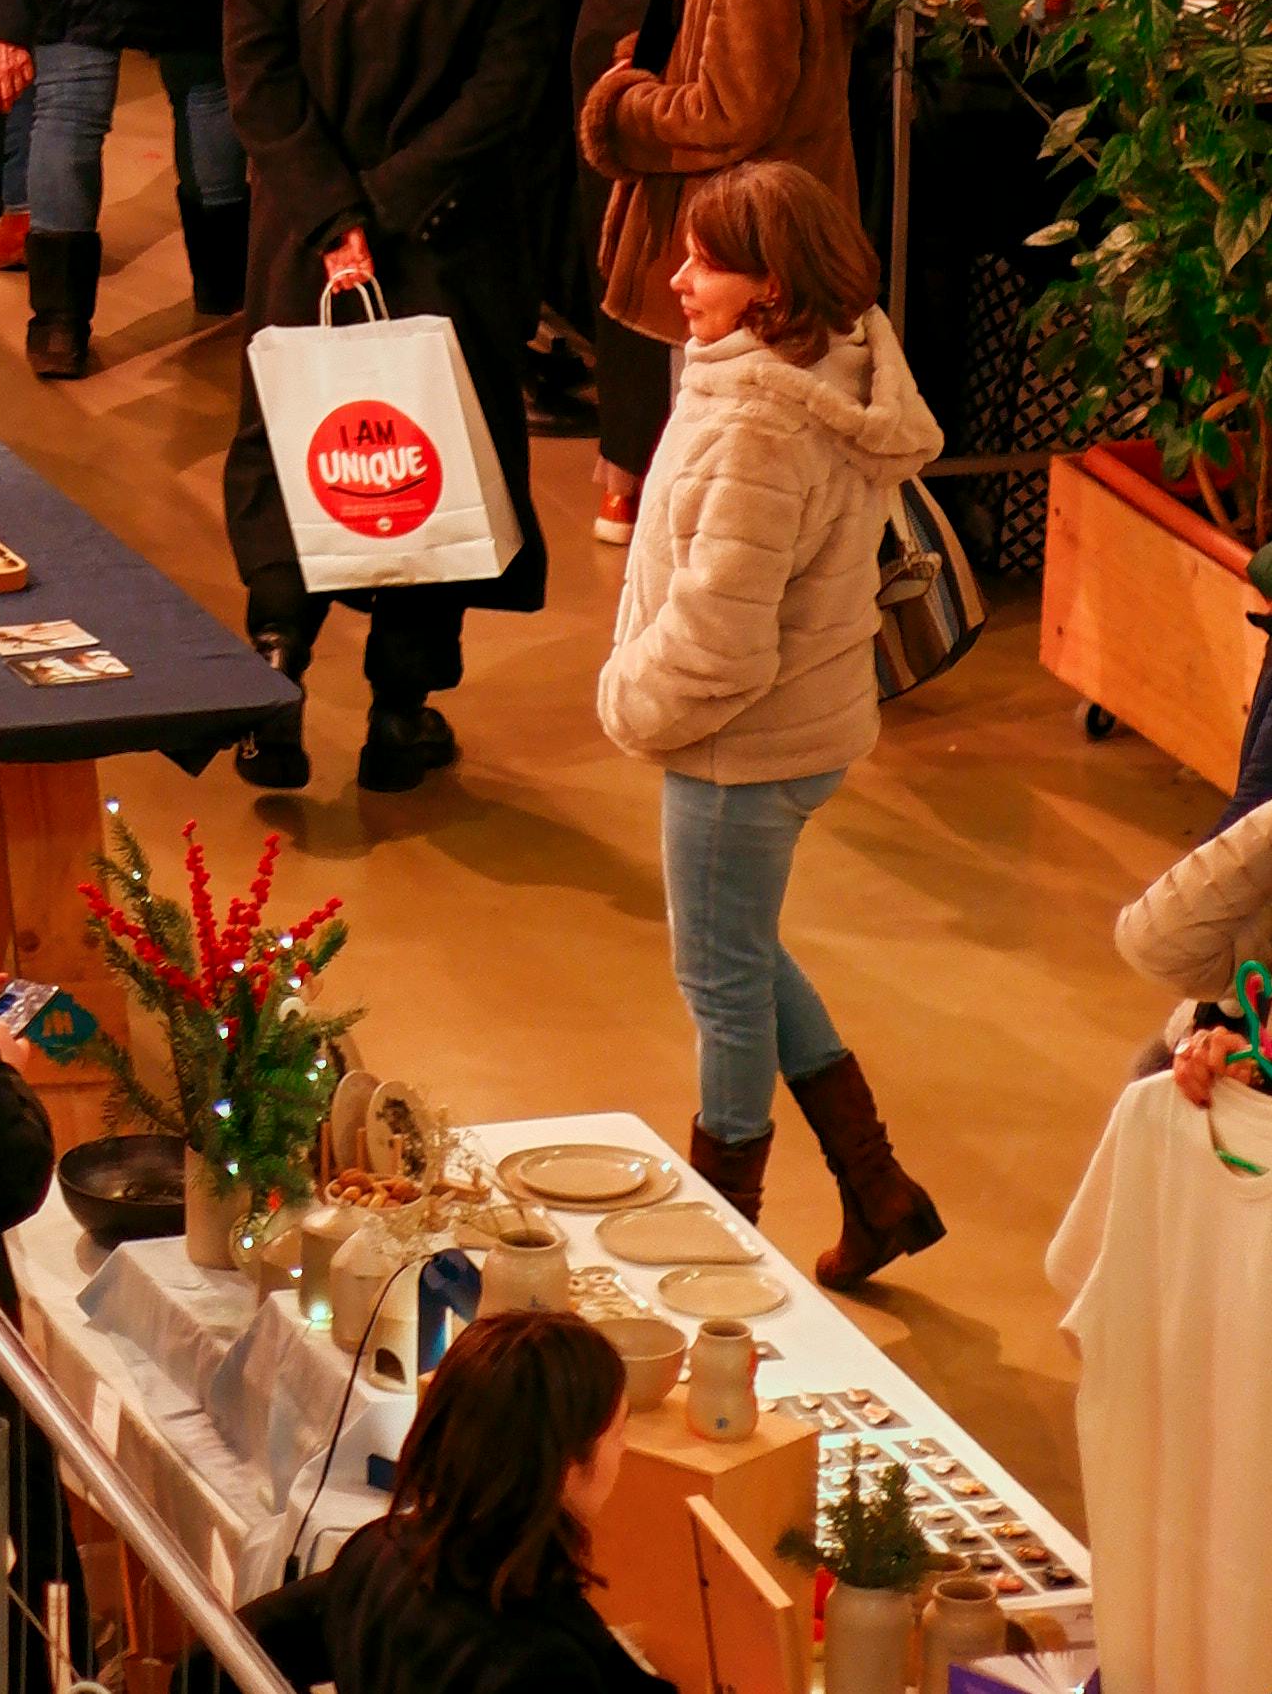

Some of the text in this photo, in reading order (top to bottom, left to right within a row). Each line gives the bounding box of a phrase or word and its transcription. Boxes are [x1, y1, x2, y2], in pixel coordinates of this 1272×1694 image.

[339, 418, 397, 447] I AM
[317, 445, 429, 489] UNIQUE
